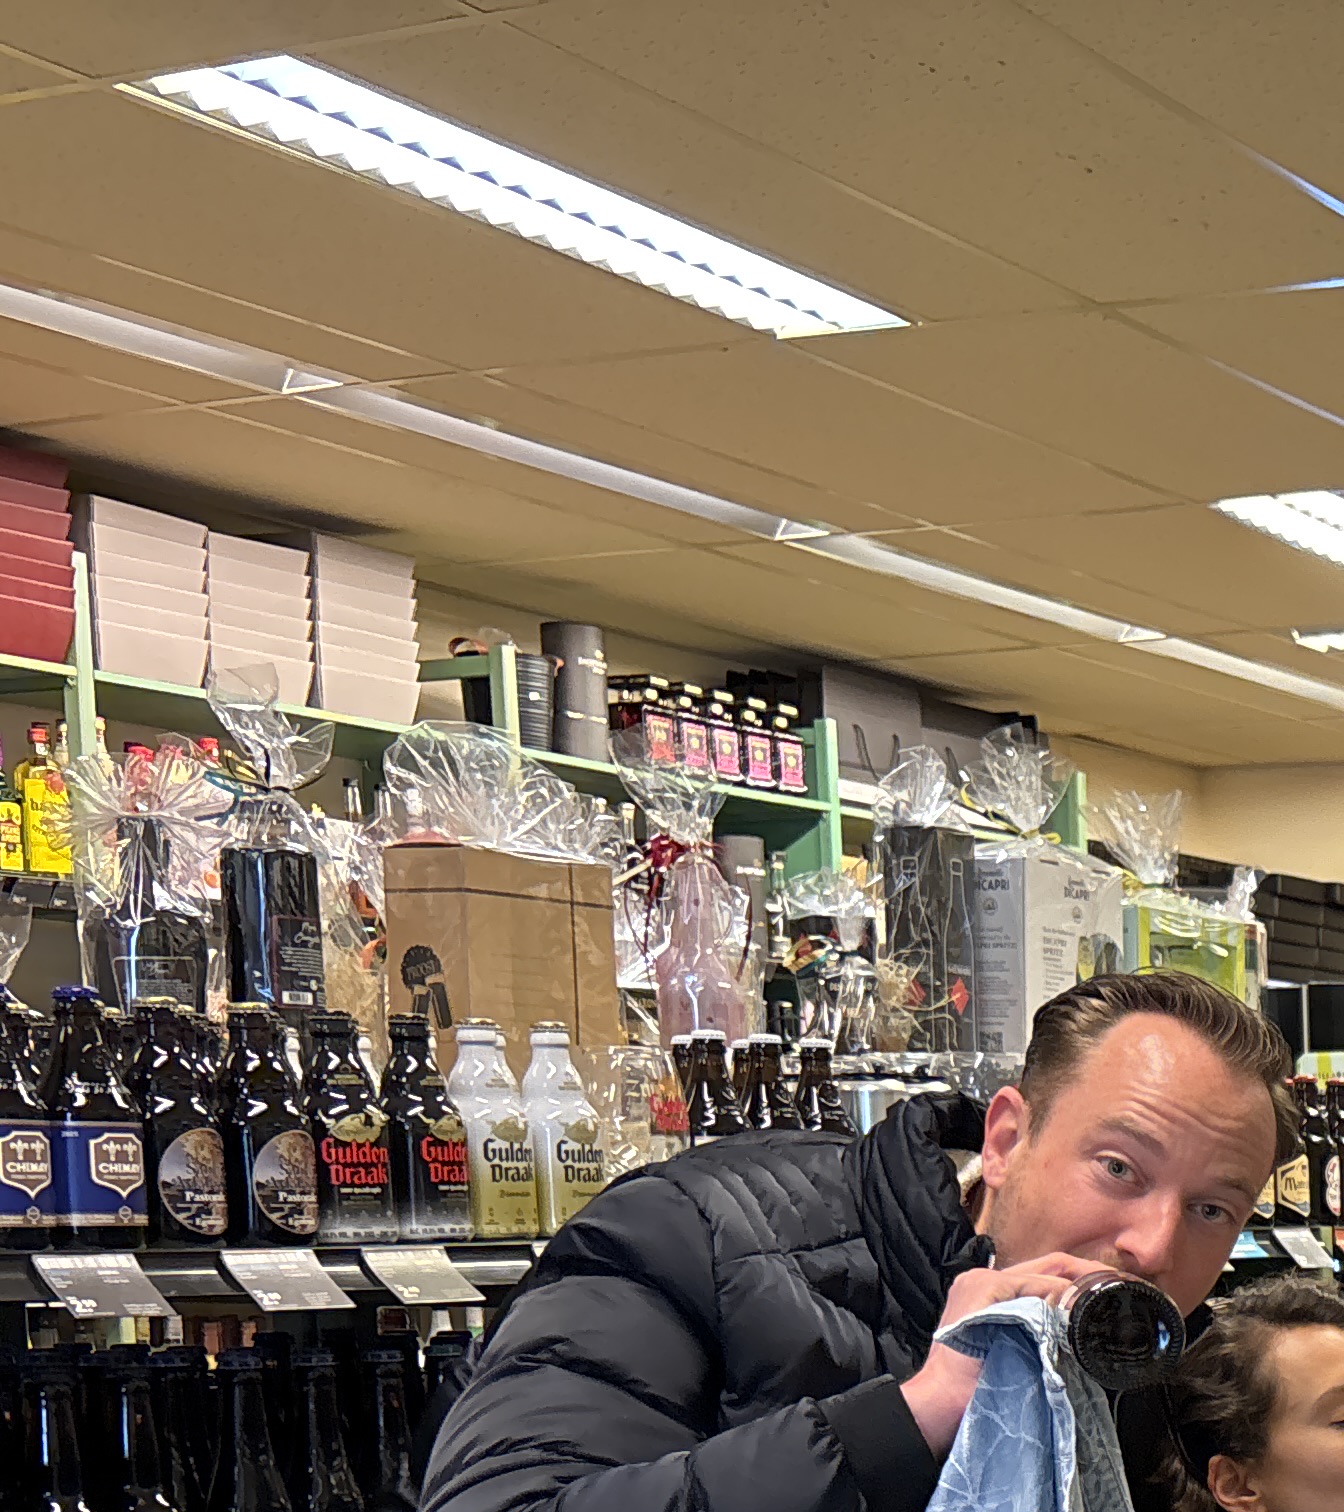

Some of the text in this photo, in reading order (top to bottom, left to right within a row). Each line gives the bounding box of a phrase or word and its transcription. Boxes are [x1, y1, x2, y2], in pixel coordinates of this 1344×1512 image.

[321, 1137, 389, 1164] Gulden
[483, 1138, 533, 1163] Gulden
[5, 1162, 48, 1174] CHIMAY
[98, 1162, 140, 1174] CHIMAY
[330, 1163, 389, 1186] Draak
[490, 1163, 533, 1183] Draak
